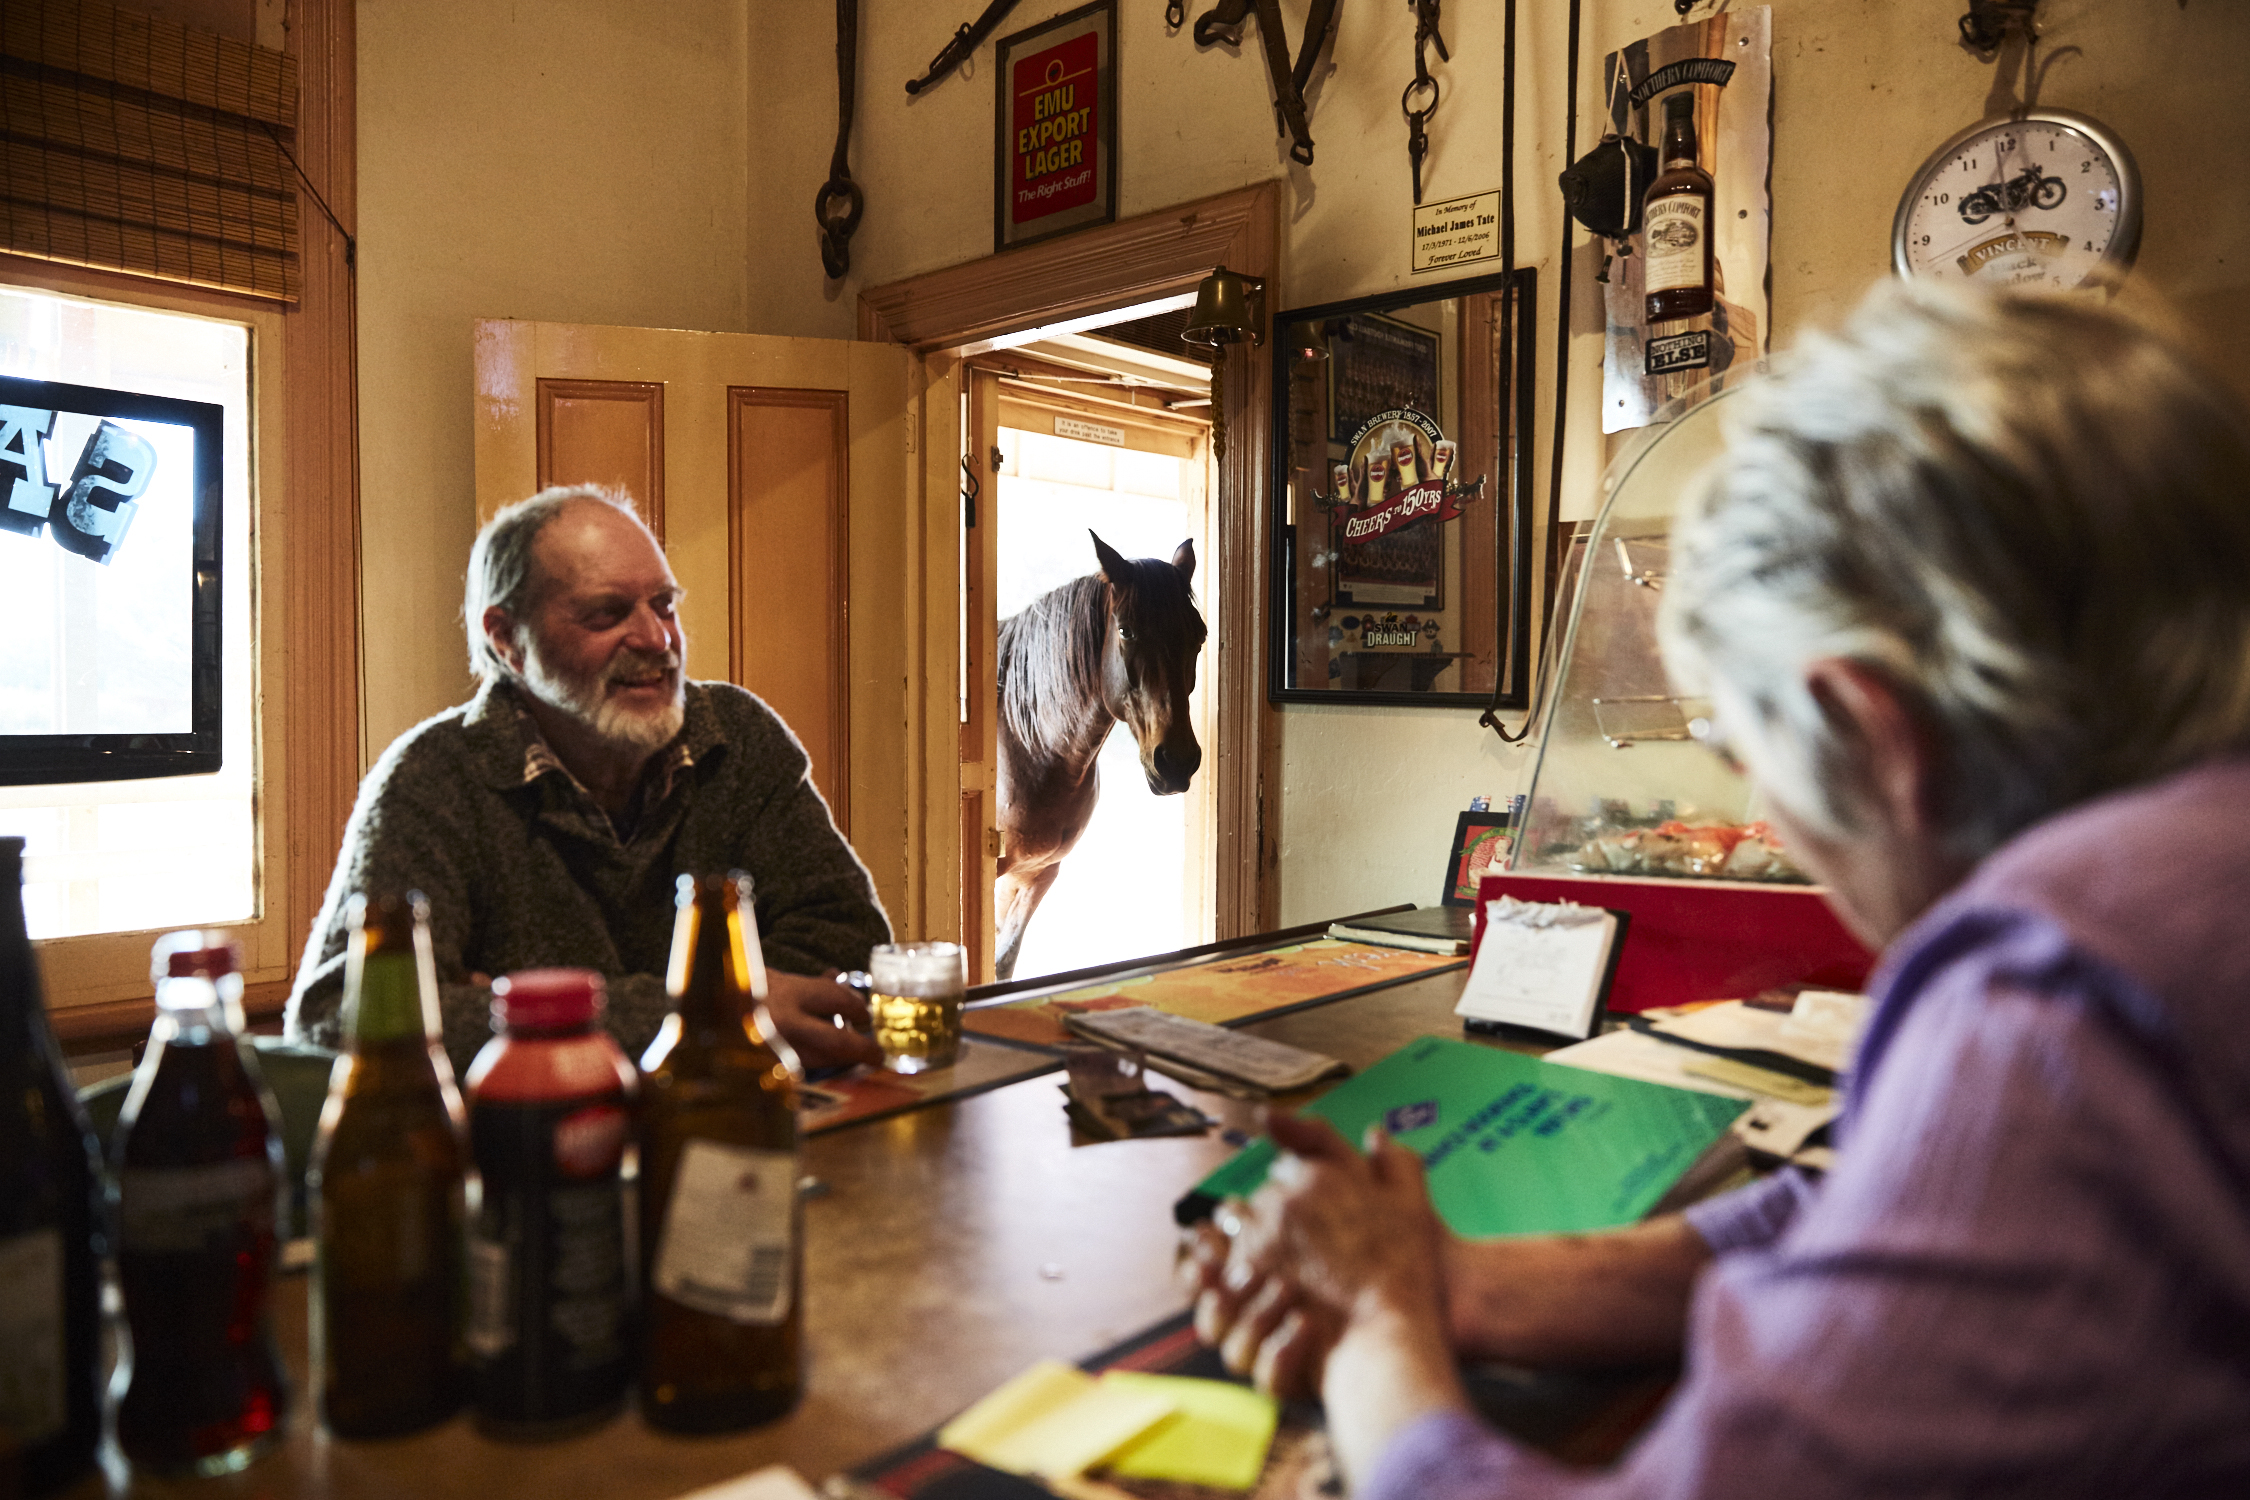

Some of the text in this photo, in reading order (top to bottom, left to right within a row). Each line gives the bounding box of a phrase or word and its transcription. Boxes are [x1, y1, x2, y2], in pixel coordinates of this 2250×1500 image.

[1631, 61, 1733, 101] SOUTHERN COMFORT
[1034, 84, 1074, 121] EMU
[1019, 107, 1091, 154] EXPORT
[2000, 138, 2016, 153] 12
[2049, 140, 2055, 151] 1
[1025, 139, 1083, 181] LAGER
[1962, 159, 1977, 171] 11
[2081, 161, 2091, 173] 2
[1018, 169, 1091, 203] The Right Stuff!
[1444, 204, 1468, 214] Memory
[1469, 200, 1477, 210] of
[1933, 193, 1949, 206] 10
[2094, 198, 2104, 211] 3
[1668, 200, 1702, 219] COMFORT
[1417, 214, 1494, 237] Michael James Tate
[1921, 234, 1931, 246] 9
[1975, 238, 2050, 261] VINCENT
[2084, 240, 2093, 253] 4
[1428, 246, 1482, 265] Forever Loved
[1651, 334, 1703, 355] NOTHING
[1652, 344, 1705, 369] ELSE
[1350, 424, 1368, 447] SWAN
[1367, 410, 1402, 428] BREWERY
[1346, 508, 1392, 537] CHEERS
[1375, 624, 1407, 632] SWAN
[1367, 630, 1417, 647] DRAUGHT
